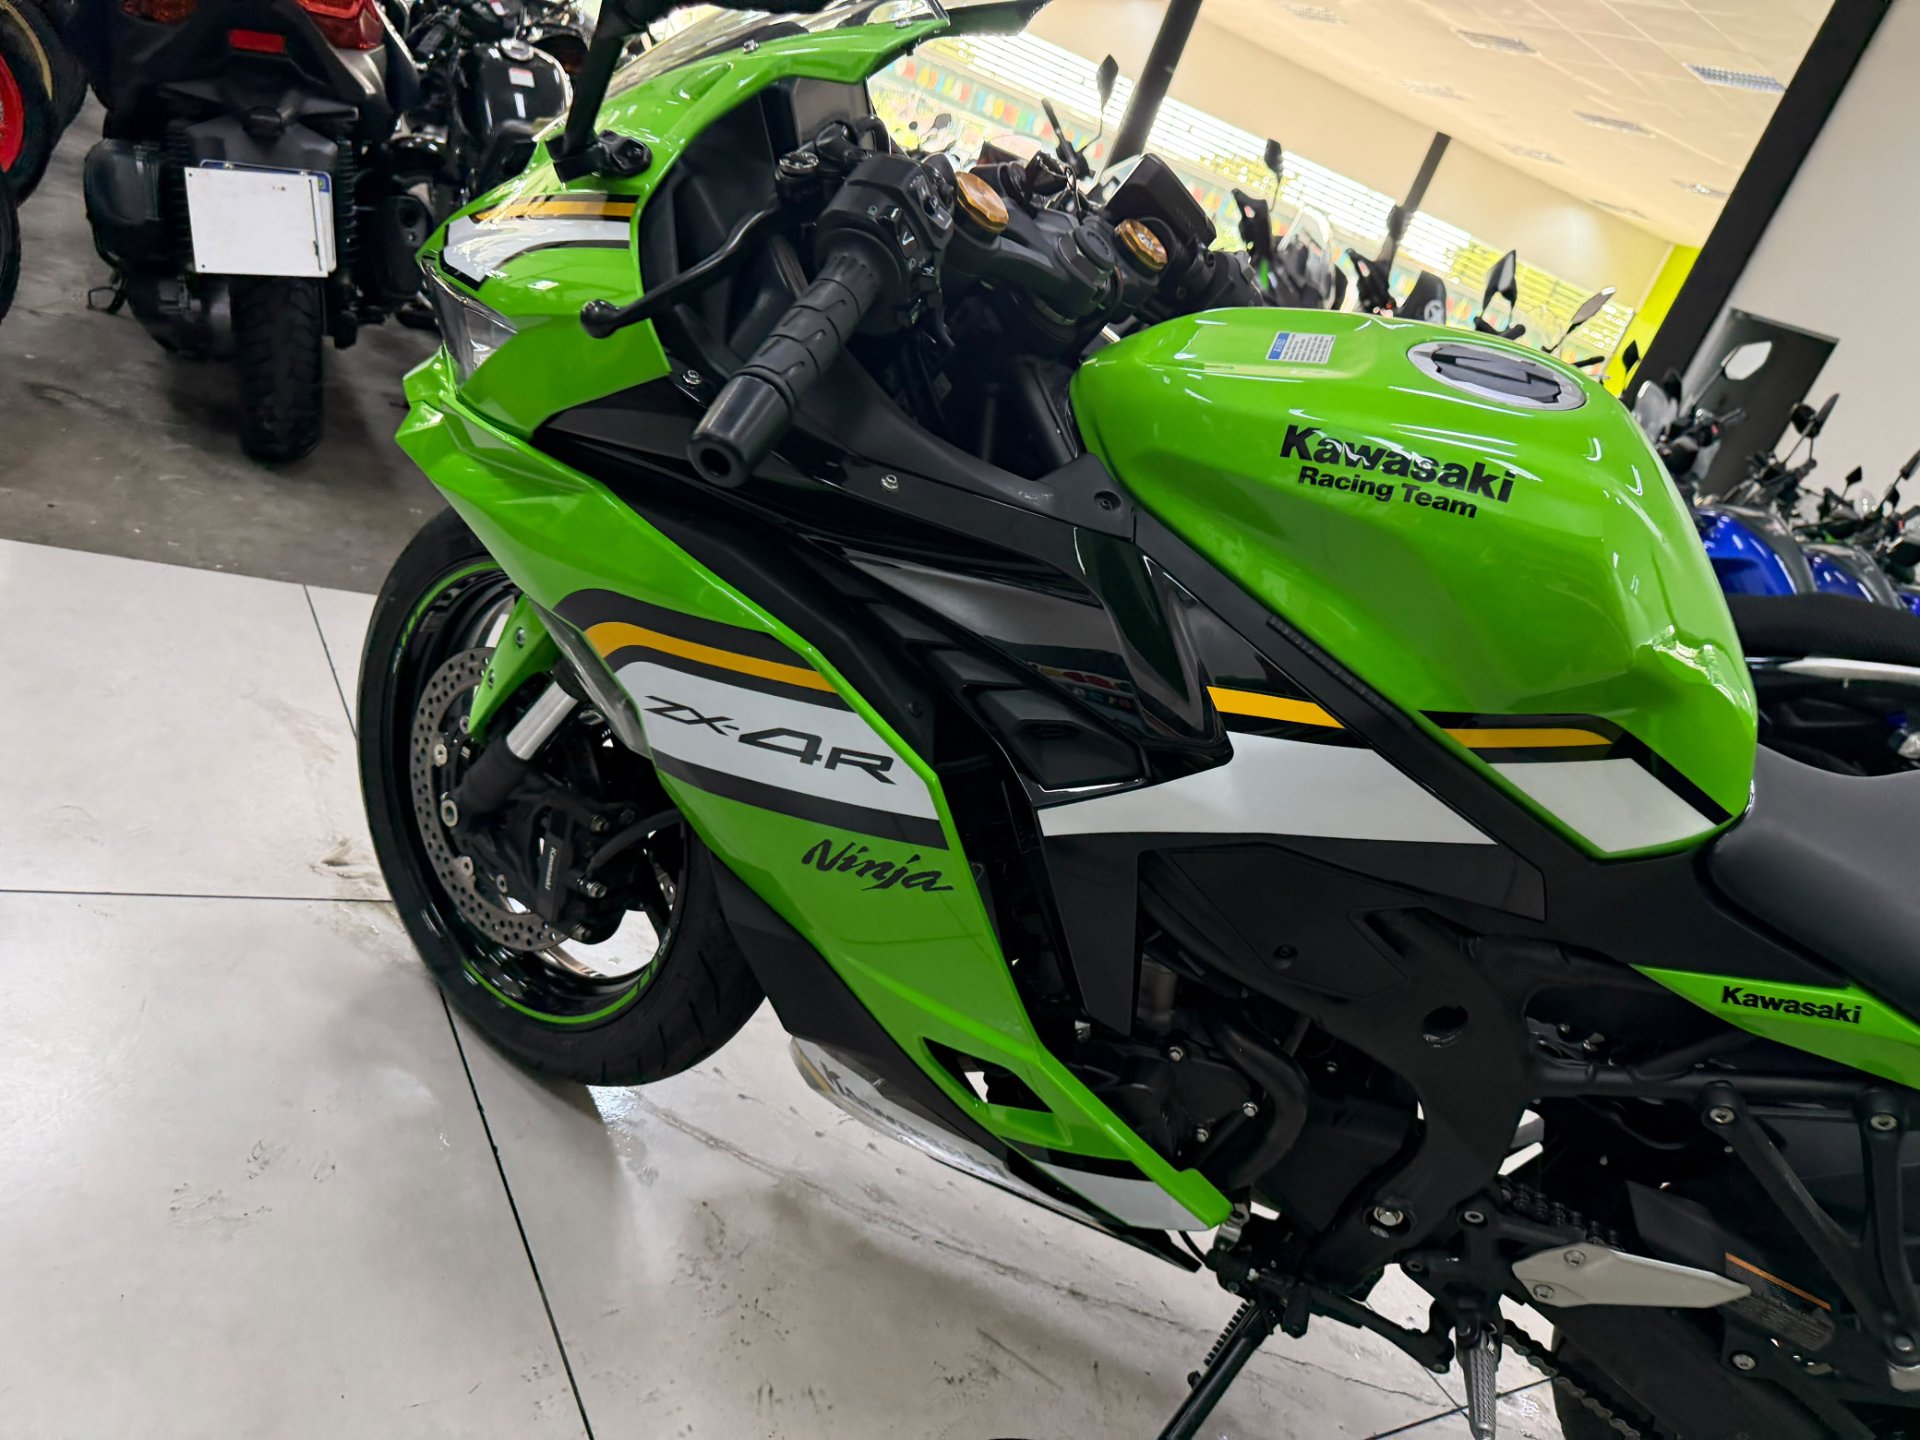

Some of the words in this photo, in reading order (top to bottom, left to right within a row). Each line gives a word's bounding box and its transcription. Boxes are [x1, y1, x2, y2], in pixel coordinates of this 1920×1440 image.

[1280, 424, 1516, 503] Kawasaki
[1298, 465, 1394, 502] Racing
[1400, 483, 1478, 518] Team
[644, 695, 898, 786] ZX-4R
[801, 838, 954, 892] Ninja
[1720, 985, 1862, 1024] Kawasaki
